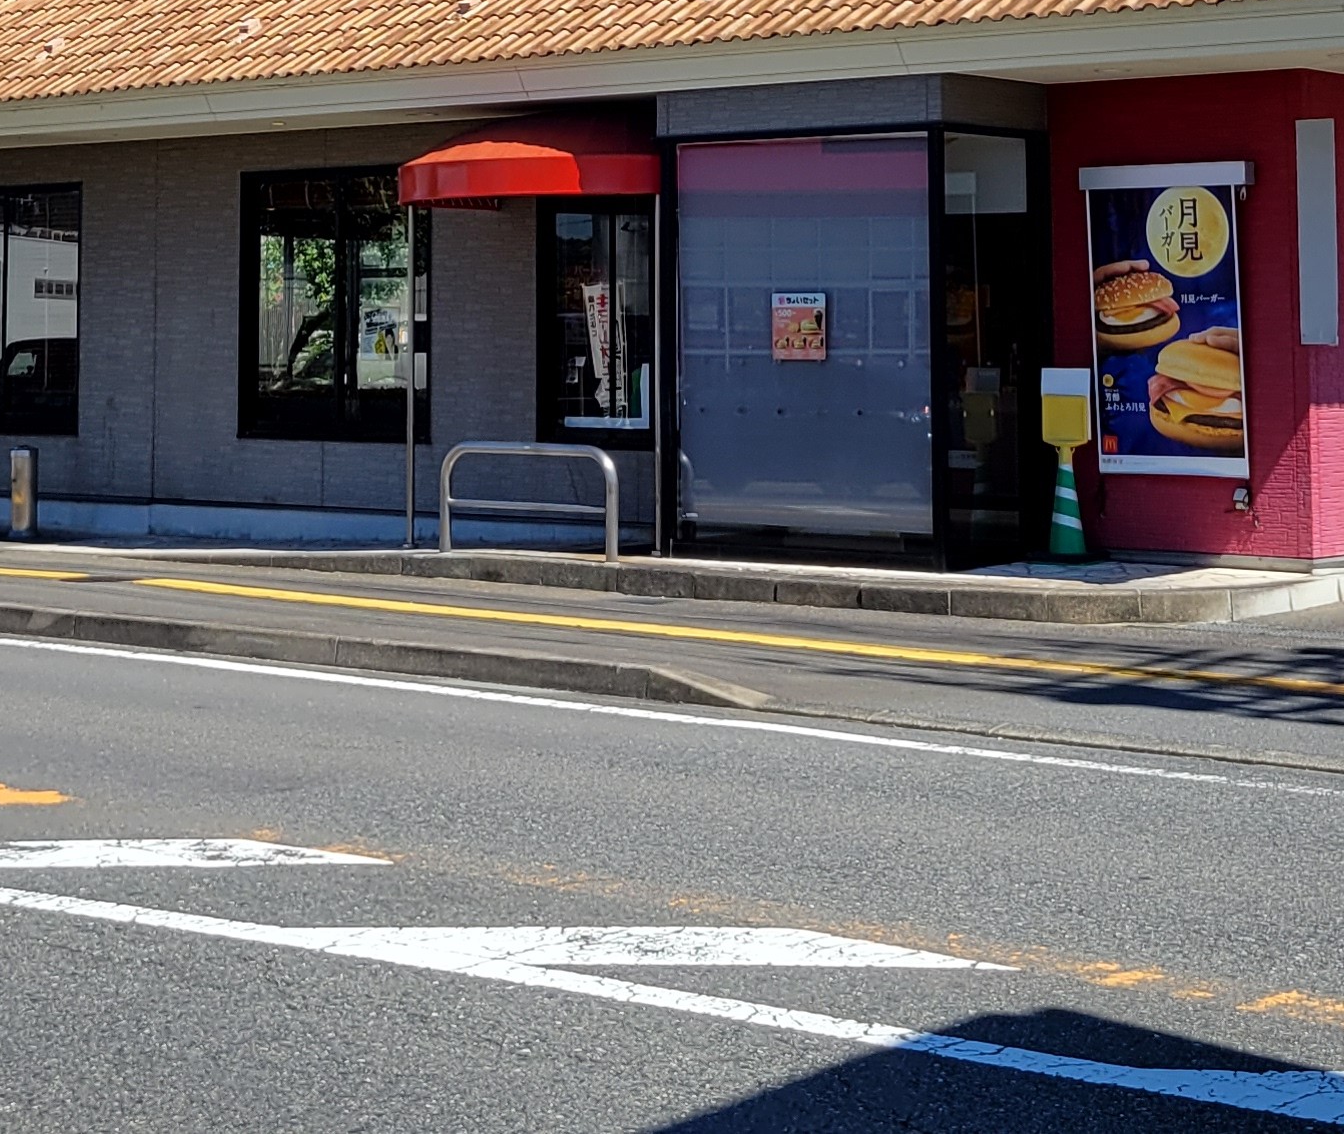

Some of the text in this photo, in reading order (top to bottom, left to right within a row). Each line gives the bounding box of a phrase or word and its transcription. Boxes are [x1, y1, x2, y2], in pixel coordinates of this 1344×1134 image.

[1159, 205, 1175, 263] バーガー
[1177, 197, 1204, 262] 月見
[1180, 293, 1225, 304] 月見バーガー
